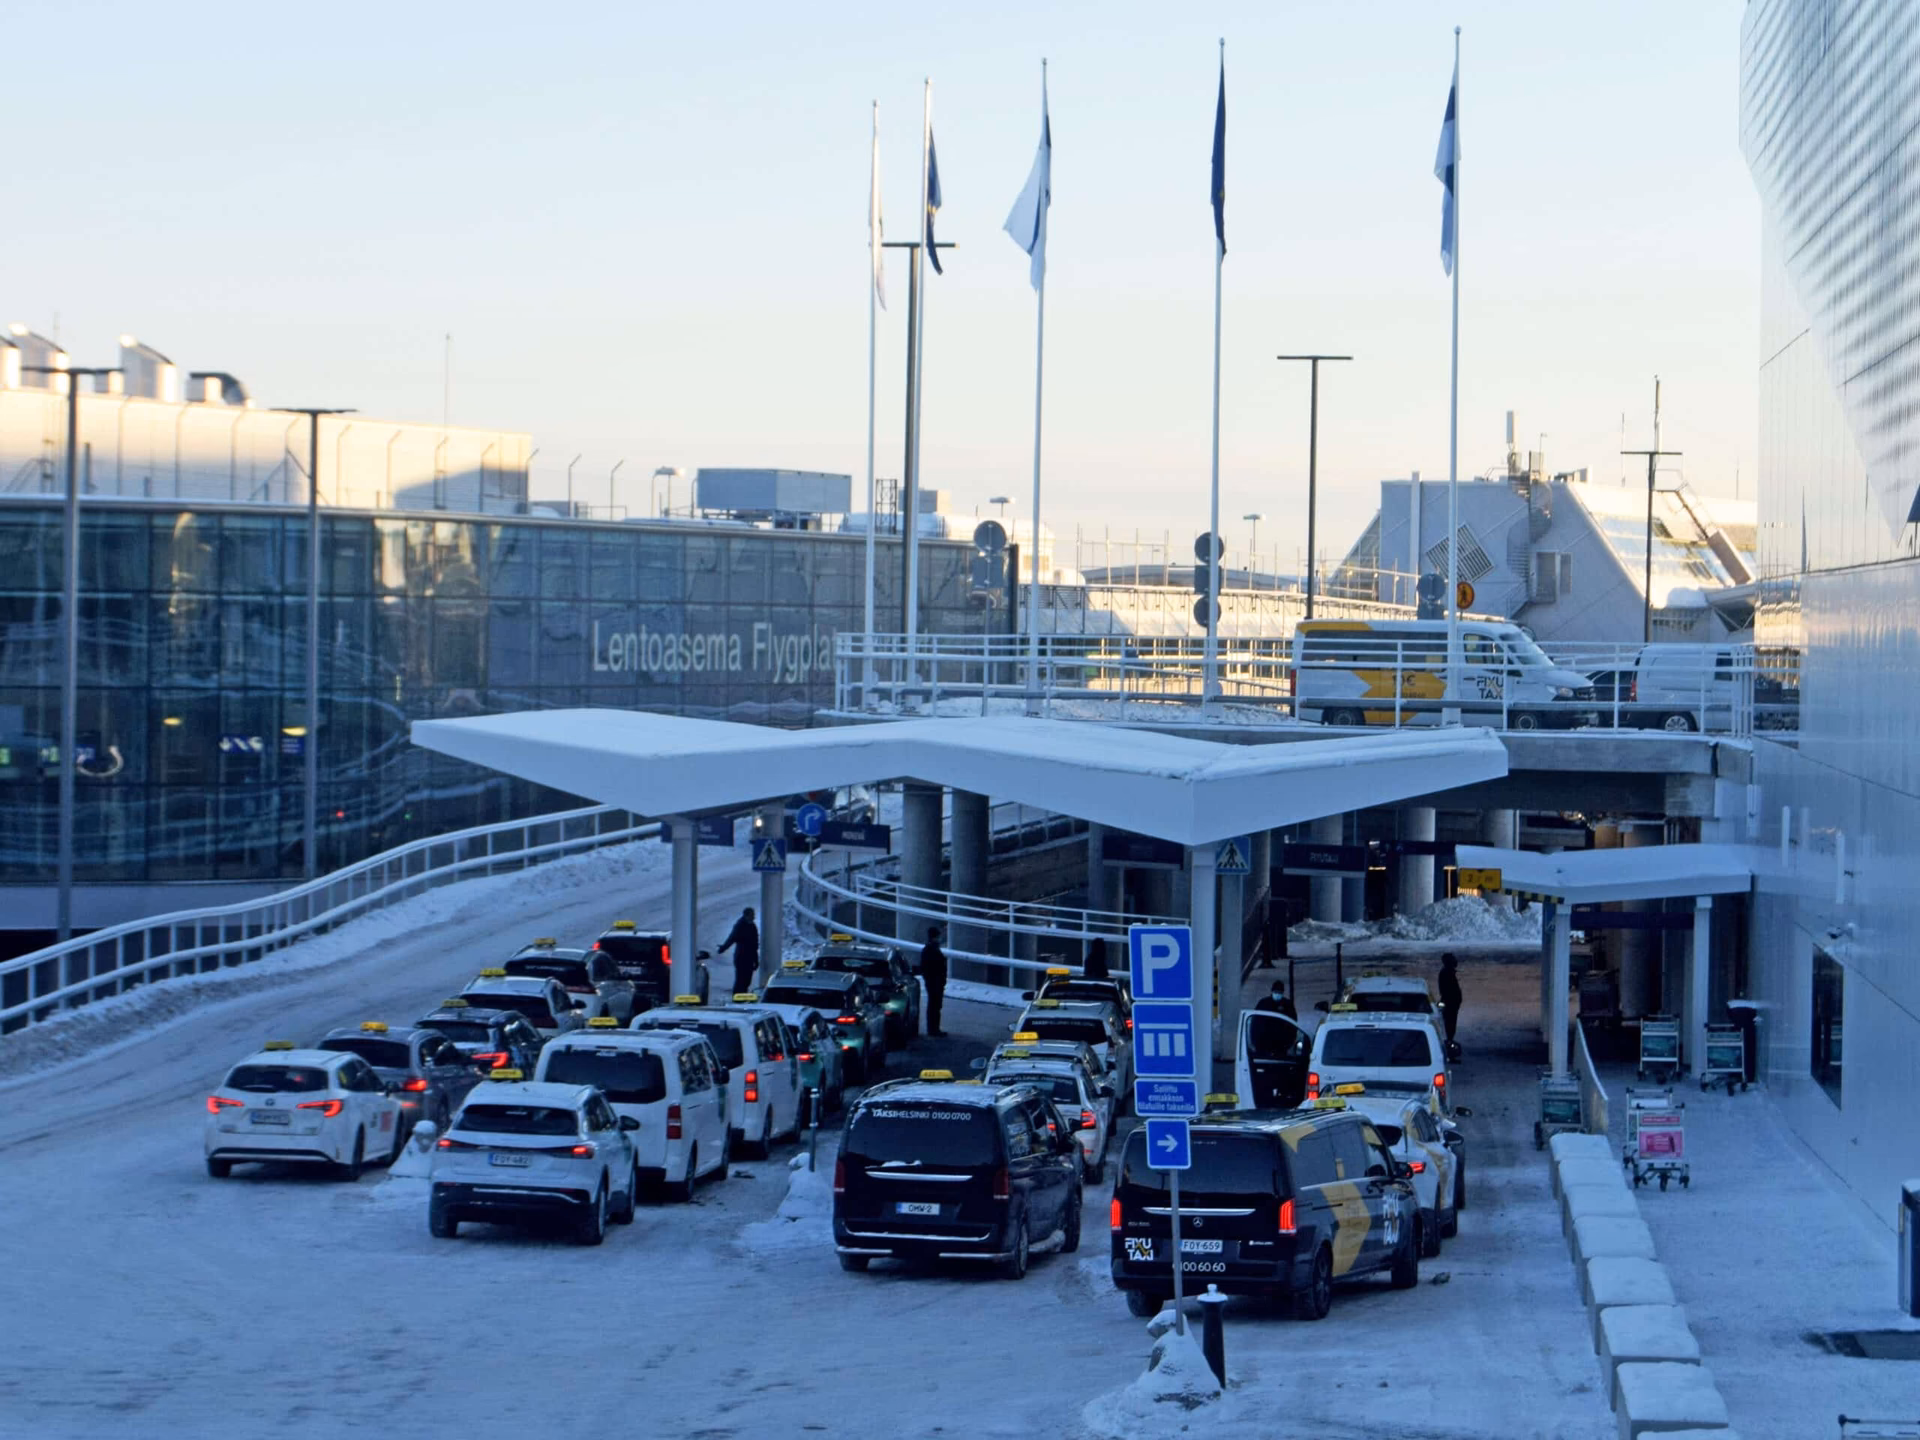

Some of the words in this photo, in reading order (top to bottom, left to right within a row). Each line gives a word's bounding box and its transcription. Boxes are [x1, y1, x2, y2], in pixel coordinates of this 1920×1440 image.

[592, 620, 742, 672] Lentoasema
[1140, 933, 1181, 994] P
[1124, 1237, 1152, 1249] FIXU
[1127, 1249, 1154, 1261] TAXI
